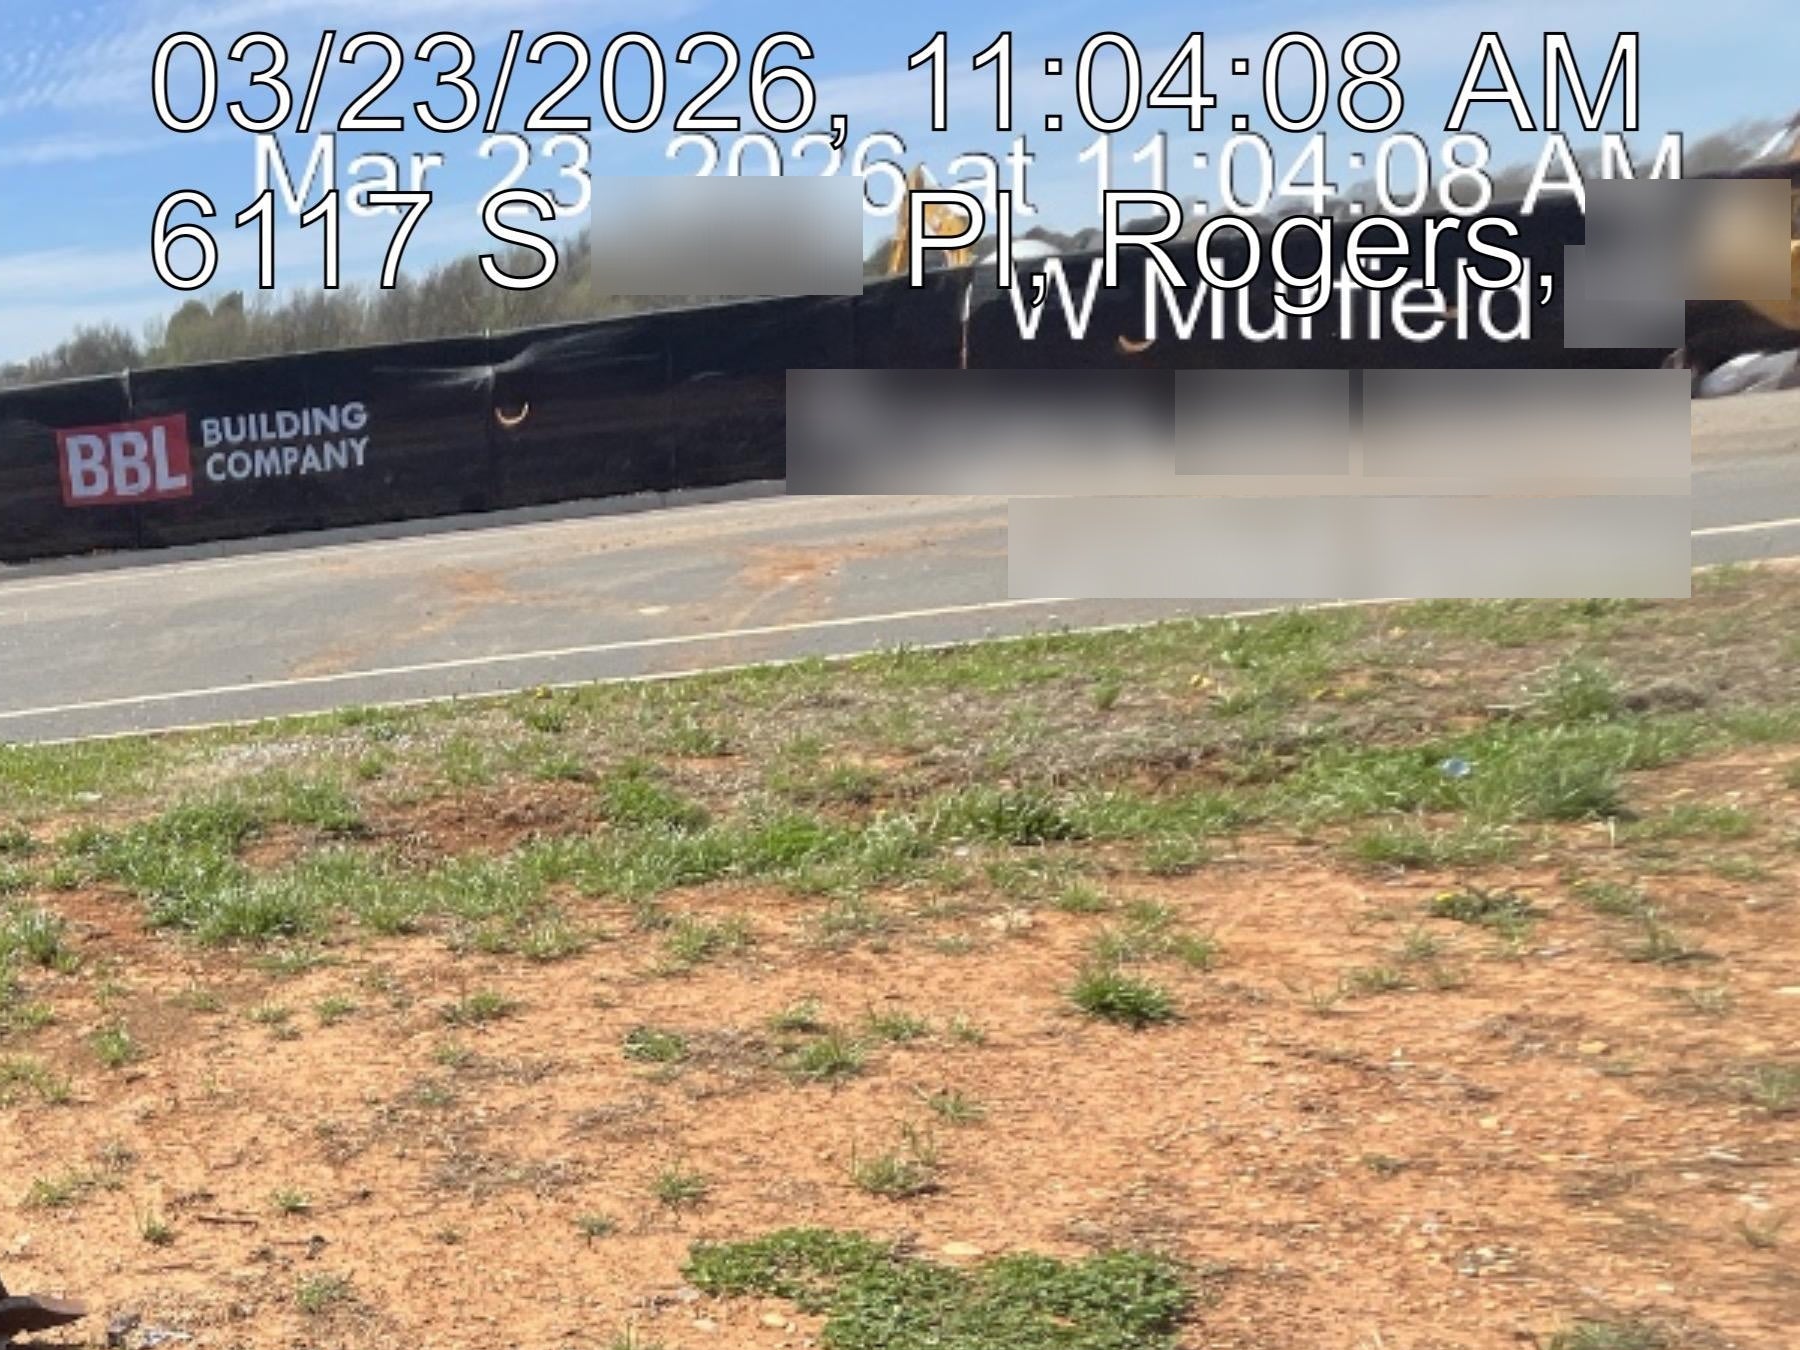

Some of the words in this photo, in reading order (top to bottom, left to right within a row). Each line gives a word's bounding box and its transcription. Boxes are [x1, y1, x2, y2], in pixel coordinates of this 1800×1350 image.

[200, 401, 368, 448] BUILDING
[65, 426, 189, 498] BBL
[205, 435, 370, 482] COMPANY
